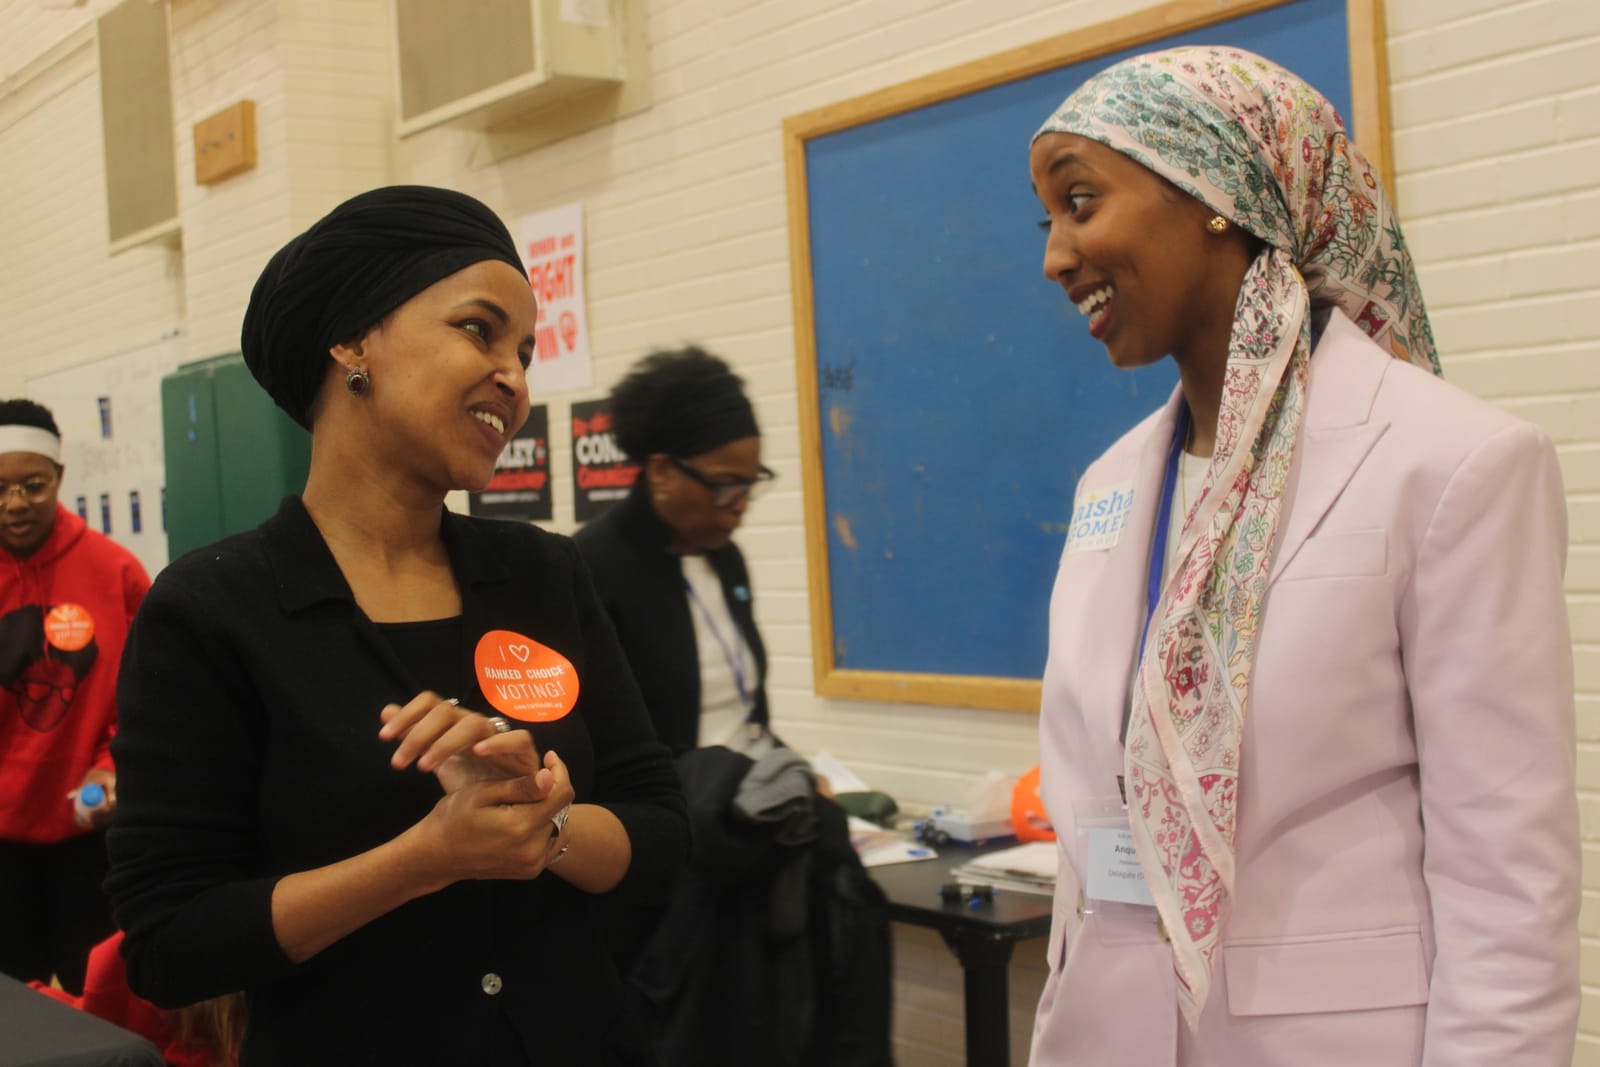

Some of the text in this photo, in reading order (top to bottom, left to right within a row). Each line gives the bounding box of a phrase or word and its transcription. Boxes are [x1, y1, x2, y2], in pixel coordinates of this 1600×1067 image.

[575, 432, 628, 466] CON
[499, 645, 506, 662] I
[484, 665, 564, 679] RANKED CHOICE
[495, 681, 566, 701] VOTING!
